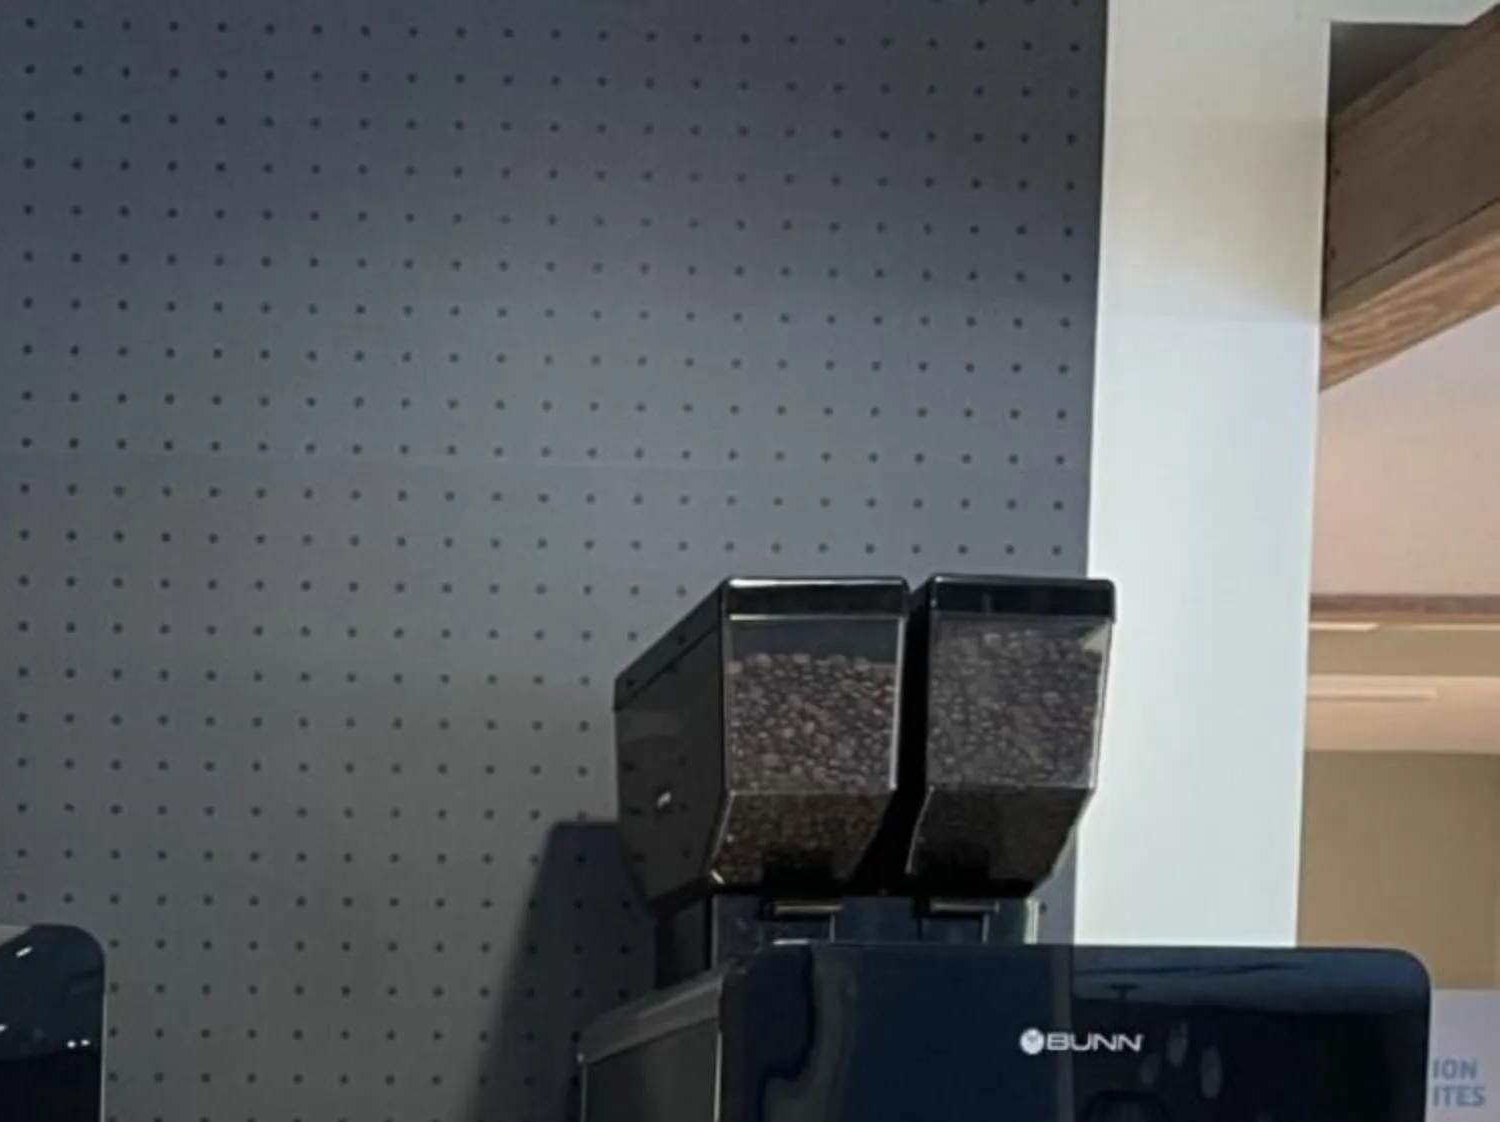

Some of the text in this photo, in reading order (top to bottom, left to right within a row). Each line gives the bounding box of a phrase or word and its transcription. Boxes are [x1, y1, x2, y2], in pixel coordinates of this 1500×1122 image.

[1046, 1033, 1142, 1051] BUNN
[1432, 1057, 1477, 1080] ION
[1432, 1085, 1487, 1108] ITES
